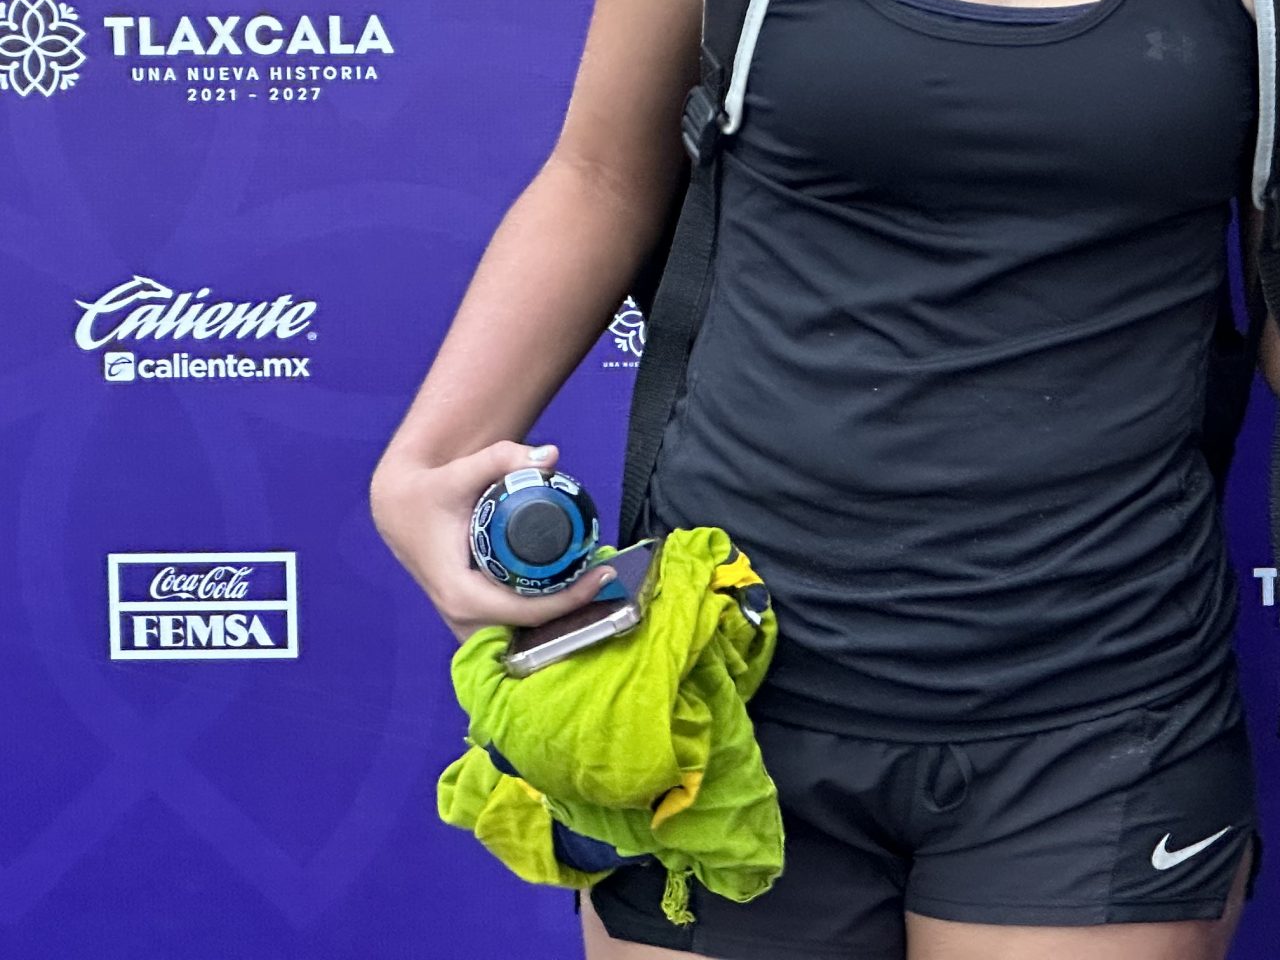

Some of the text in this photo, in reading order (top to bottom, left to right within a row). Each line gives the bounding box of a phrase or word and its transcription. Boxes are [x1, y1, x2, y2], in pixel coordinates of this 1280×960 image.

[103, 14, 395, 56] TLAXCALA
[131, 65, 378, 82] UNA NUEVA HISTORIA
[187, 88, 237, 102] 2021
[269, 86, 322, 101] 2027
[75, 275, 317, 351] Caliente
[137, 352, 310, 379] caliente.mx
[150, 565, 254, 600] Coca-Cola
[132, 613, 277, 647] FEMSA
